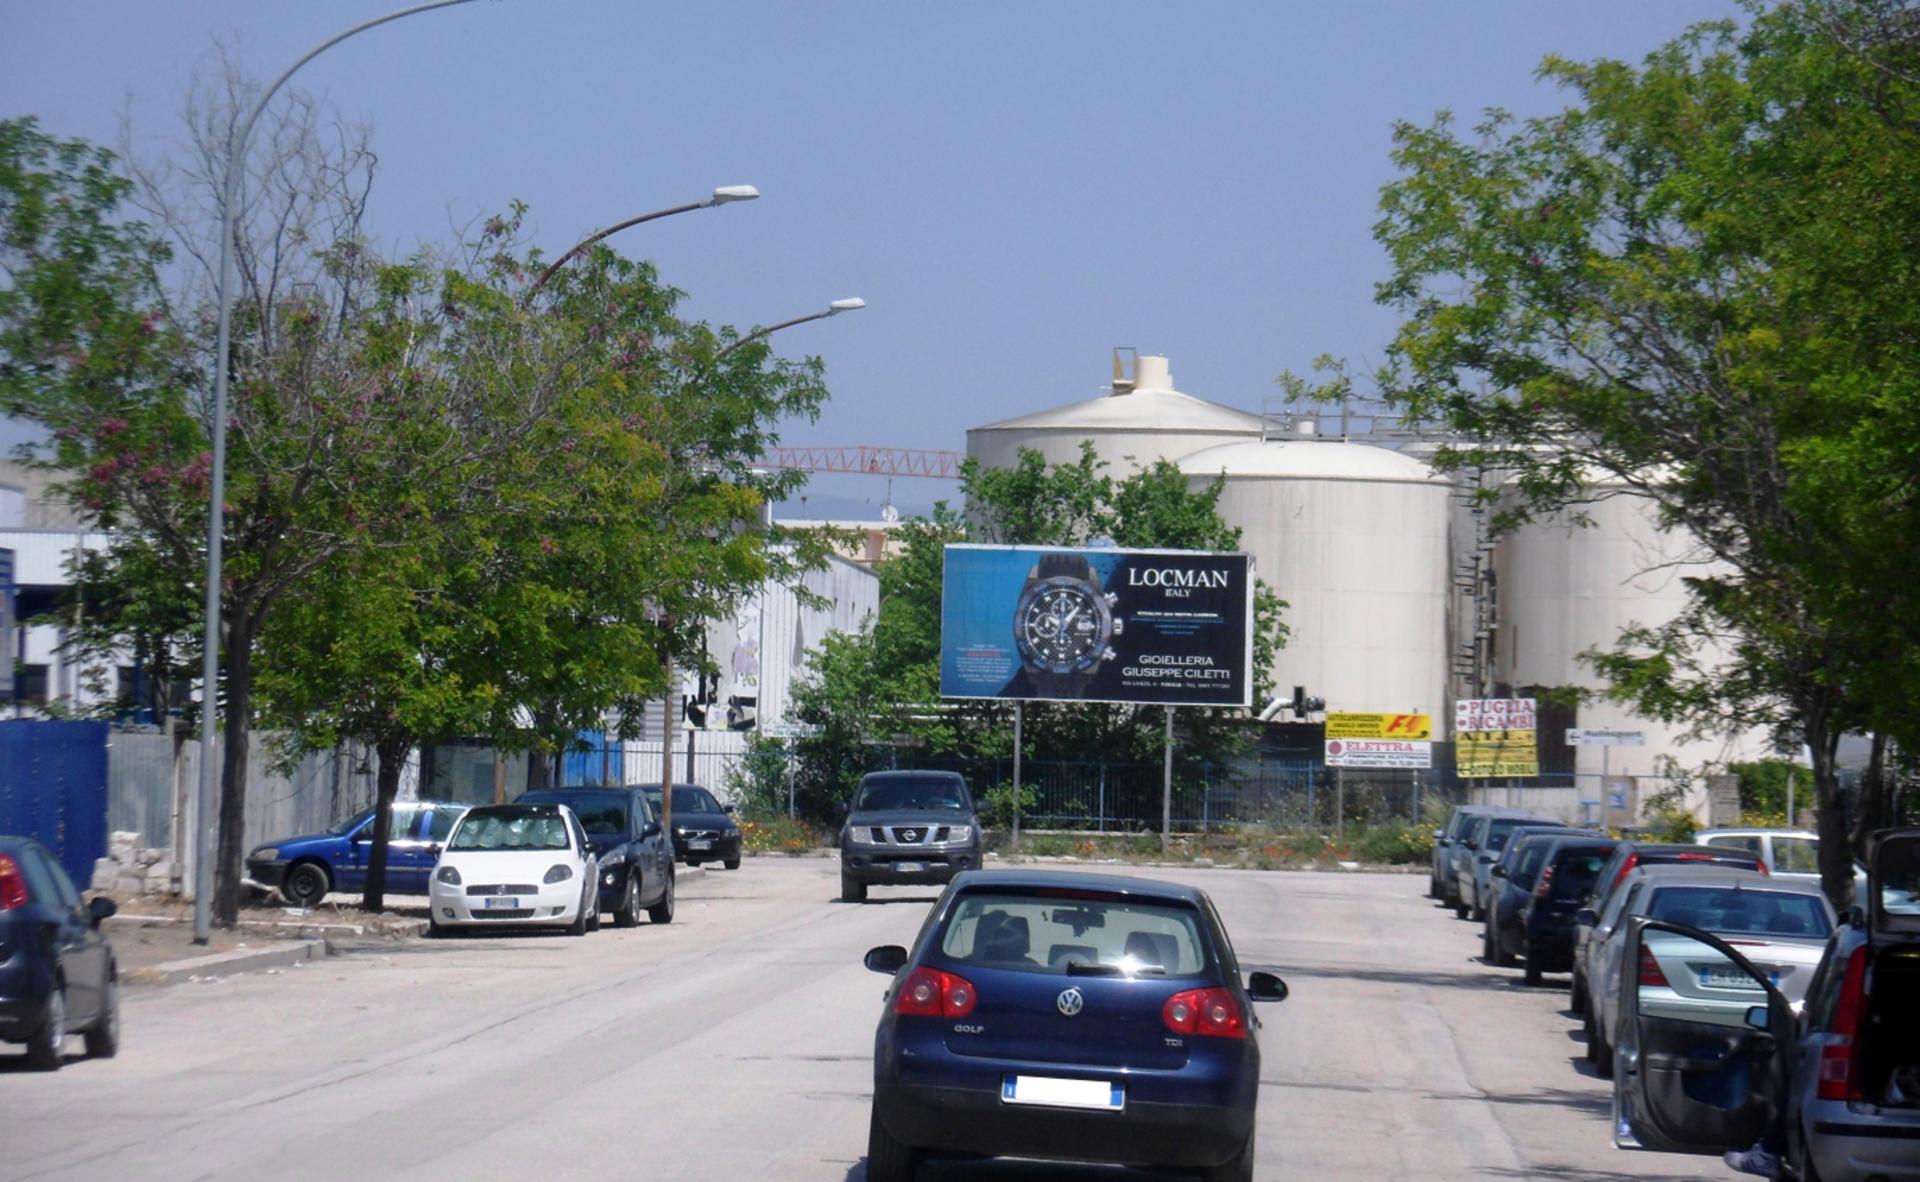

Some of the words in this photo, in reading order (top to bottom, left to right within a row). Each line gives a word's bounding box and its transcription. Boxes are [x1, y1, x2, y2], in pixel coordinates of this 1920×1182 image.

[1128, 567, 1229, 588] LOCMAN
[1164, 588, 1191, 598] ITALY
[1139, 654, 1214, 666] GIOIELLERIA
[1121, 666, 1183, 678] GIUSEPPE
[1183, 669, 1231, 679] CILETTI
[1469, 700, 1536, 713] PUGLIA
[1468, 715, 1536, 729] RICAMBI
[1346, 741, 1414, 752] ELETTRA
[954, 1024, 984, 1034] GOLF
[1164, 1037, 1183, 1047] TDI
